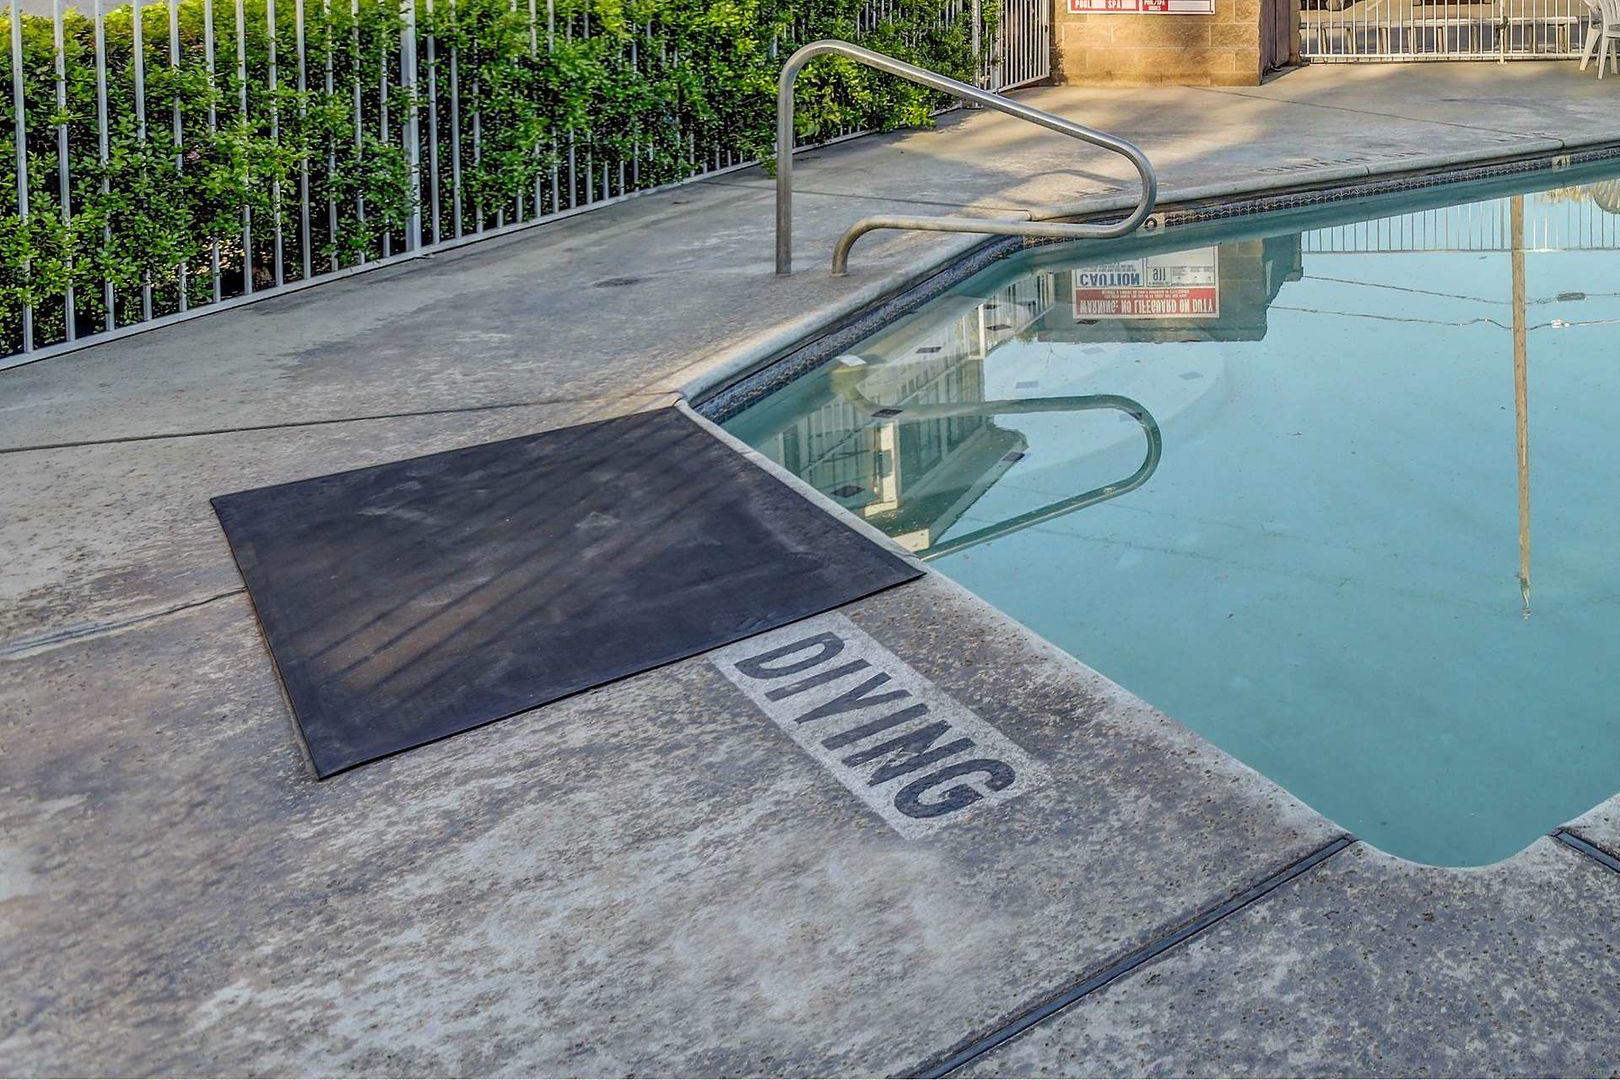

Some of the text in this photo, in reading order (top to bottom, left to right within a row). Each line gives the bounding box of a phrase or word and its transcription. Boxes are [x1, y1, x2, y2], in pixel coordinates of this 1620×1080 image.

[1075, 0, 1121, 8] POOL SPA
[734, 631, 1016, 819] DIVING
